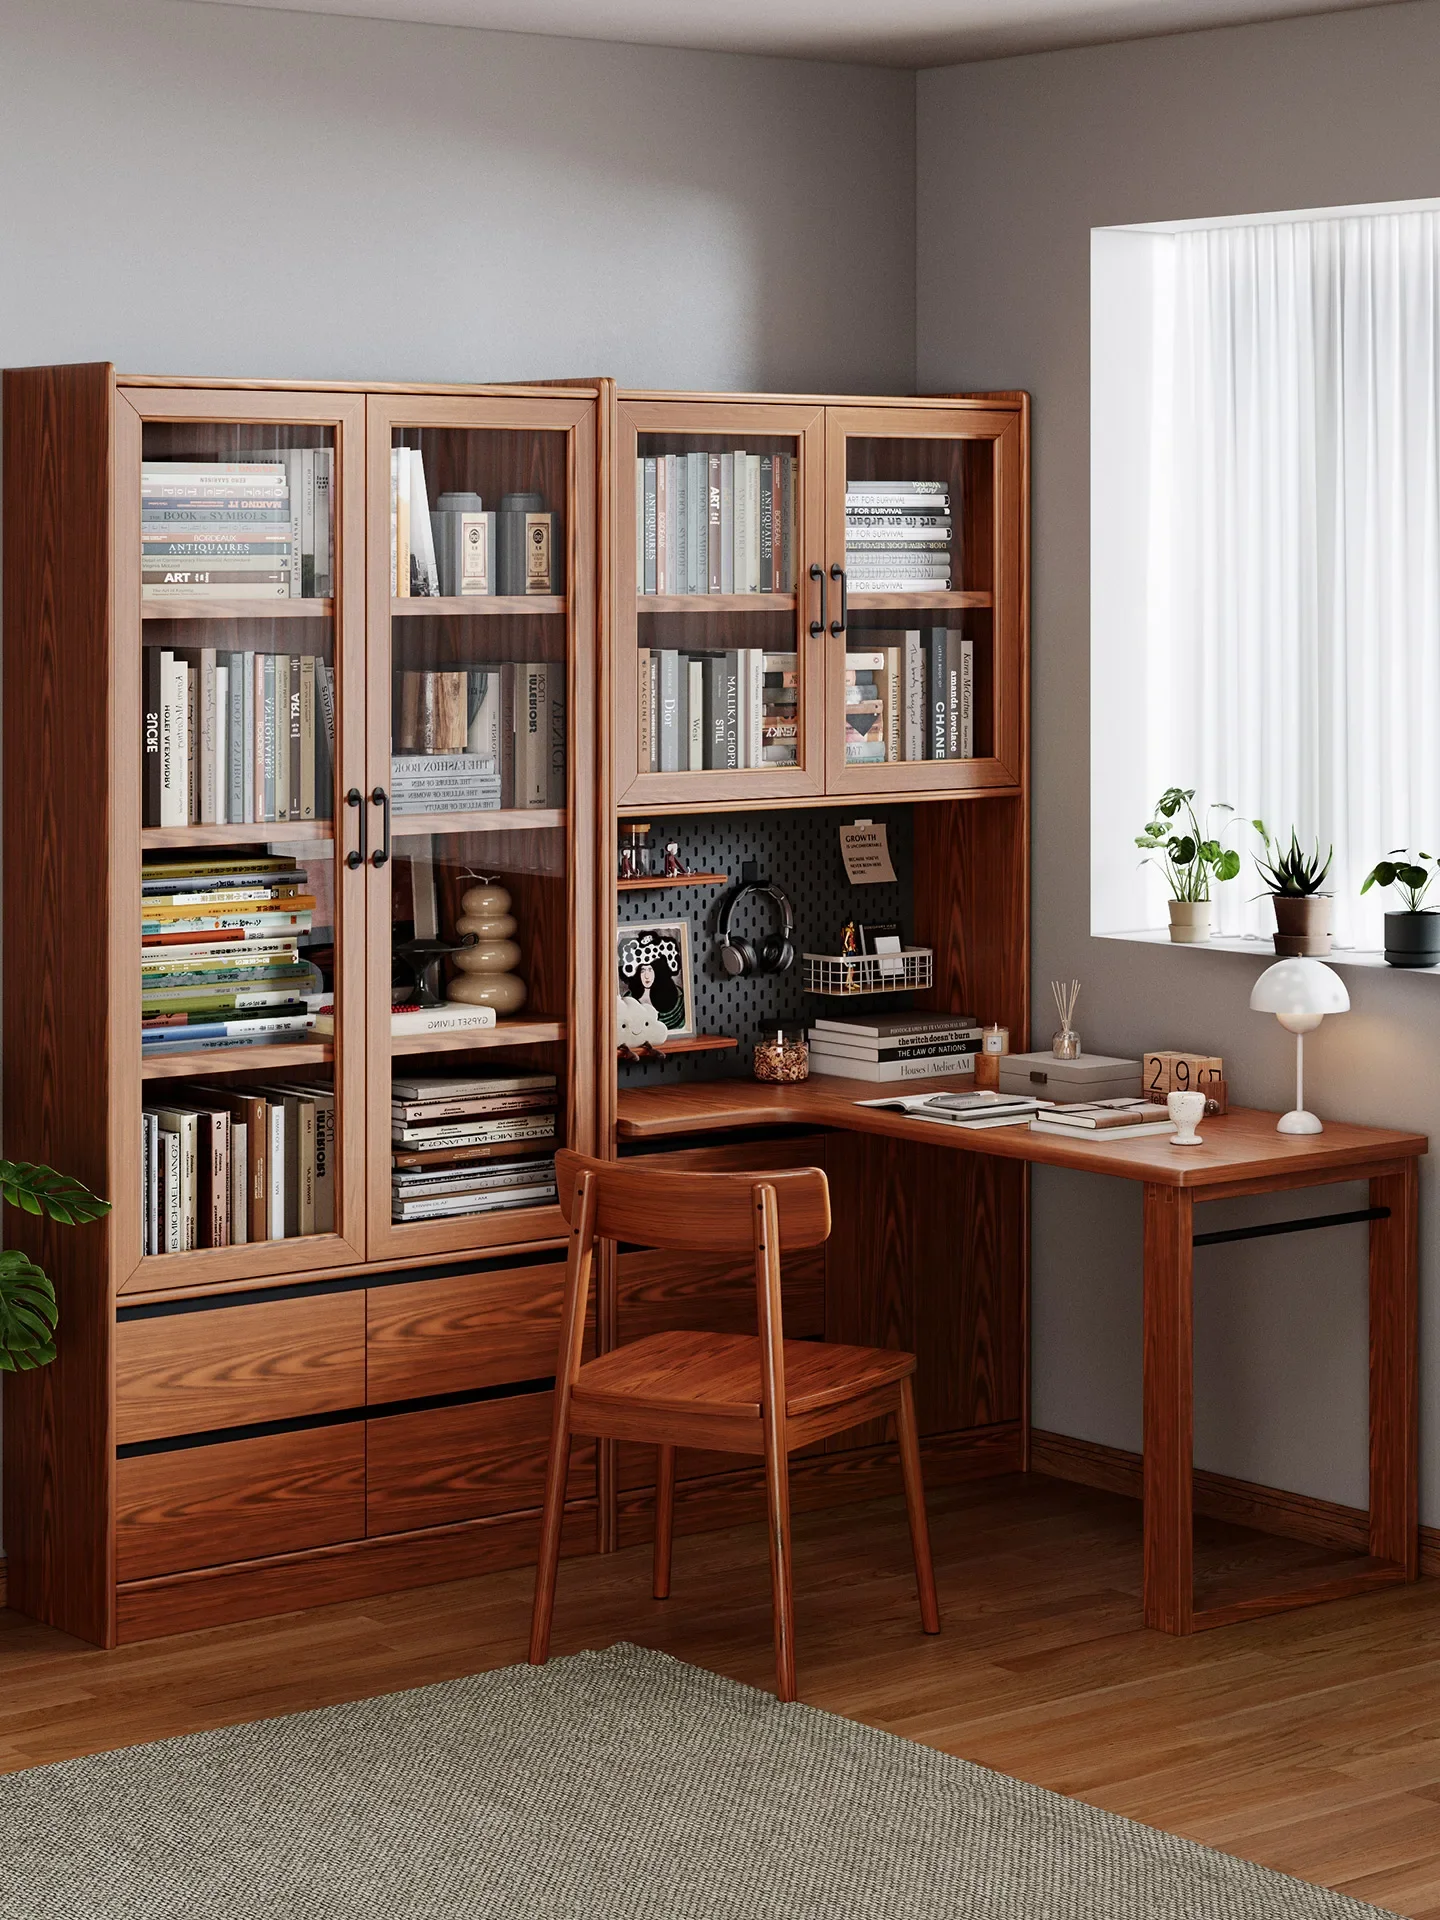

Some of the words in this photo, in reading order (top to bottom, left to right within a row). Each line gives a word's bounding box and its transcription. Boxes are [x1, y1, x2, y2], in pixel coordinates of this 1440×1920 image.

[710, 486, 720, 509] ART
[163, 511, 197, 520] BOOK
[210, 511, 268, 520] SYMBOLS
[849, 516, 884, 528] urban
[887, 517, 902, 525] an
[905, 517, 916, 528] in
[920, 517, 937, 527] art
[648, 492, 656, 560] ANTIQUAIRES
[764, 490, 772, 559] ANTIQUAIRES
[169, 543, 250, 551] ANTIQUAIRES
[846, 553, 933, 564] INNENARCHITEKTU
[164, 573, 191, 583] ART
[846, 567, 934, 578] INNENARCHITEKTU
[963, 653, 971, 676] Karen
[910, 667, 919, 688] body
[891, 673, 899, 711] Arianna
[950, 670, 958, 709] amanda
[727, 676, 736, 725] MALLIKA
[962, 678, 971, 719] McCartney
[322, 685, 334, 740] BAUHAUS
[664, 699, 676, 727] Dior
[692, 718, 701, 742] West
[715, 719, 724, 744] STILL
[890, 714, 900, 761] Huffingto
[935, 701, 945, 759] CHANE
[950, 711, 959, 752] lovelace
[845, 834, 877, 842] GROWTH
[898, 1038, 910, 1046] the
[909, 1036, 928, 1045] witch
[928, 1033, 954, 1043] doesn't
[954, 1032, 970, 1040] burn
[912, 1048, 926, 1056] LAW
[938, 1044, 967, 1053] NATIONS
[900, 1065, 926, 1076] Houses
[932, 1062, 954, 1072] Atelier
[956, 1059, 970, 1069] AM
[1149, 1057, 1163, 1090] 2
[1175, 1060, 1190, 1091] 9
[187, 1123, 192, 1131] 1
[216, 1121, 221, 1130] 2
[525, 1128, 554, 1137] WHO
[467, 1132, 512, 1142] MICHAEL
[479, 1174, 535, 1187] GLORY
[171, 1238, 178, 1250] IS
